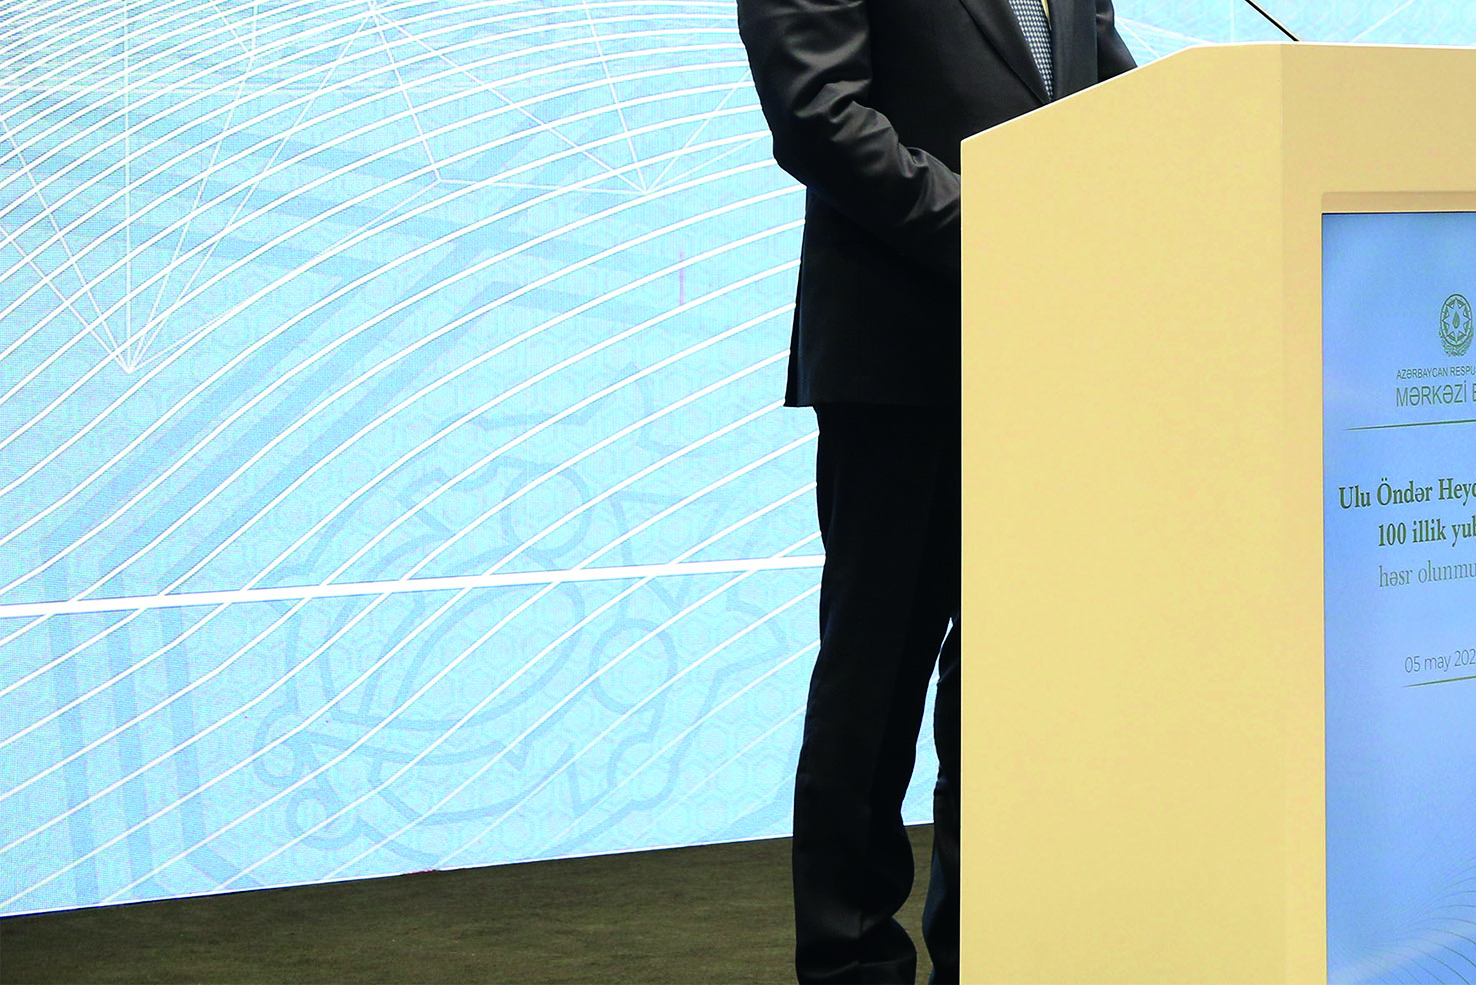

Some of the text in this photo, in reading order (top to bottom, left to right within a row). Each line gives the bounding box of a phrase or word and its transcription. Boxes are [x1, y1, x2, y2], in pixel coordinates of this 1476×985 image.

[1395, 367, 1449, 380] AZƏRBAYCAN
[1396, 380, 1467, 407] MƏRKƏZİ
[1338, 485, 1372, 509] Ulu
[1376, 477, 1433, 506] Öndər
[1378, 522, 1406, 547] 100
[1411, 518, 1447, 543] illik
[1378, 565, 1414, 588] həsr
[1404, 656, 1421, 673] 05
[1424, 655, 1452, 672] may
